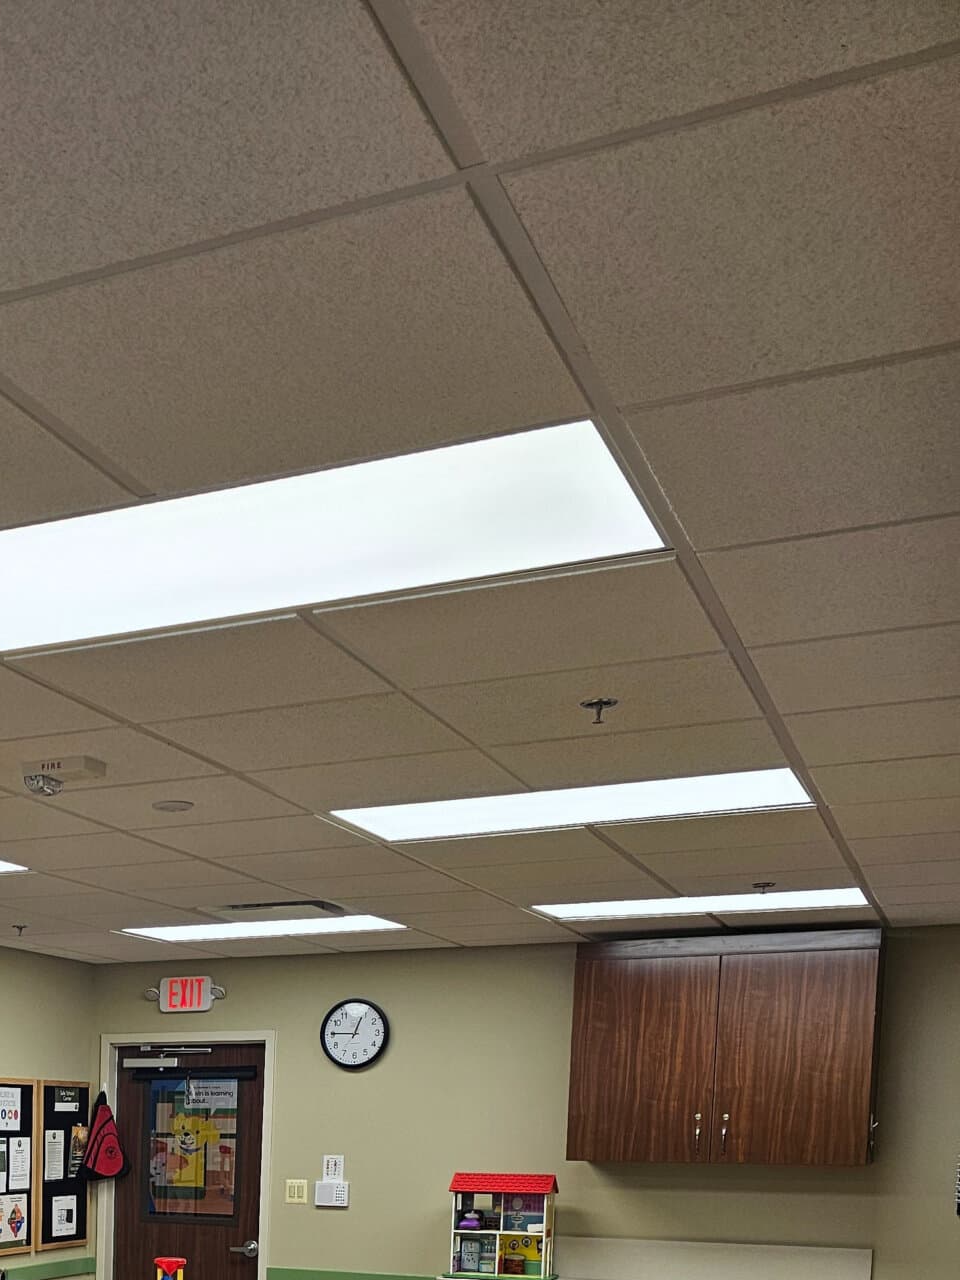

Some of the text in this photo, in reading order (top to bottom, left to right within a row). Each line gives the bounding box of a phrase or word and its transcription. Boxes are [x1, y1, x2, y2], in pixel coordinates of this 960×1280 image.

[41, 761, 62, 772] FIRE
[168, 977, 205, 1009] EXIT
[341, 1012, 347, 1020] 11
[371, 1018, 377, 1026] 2
[363, 1048, 368, 1056] 5
